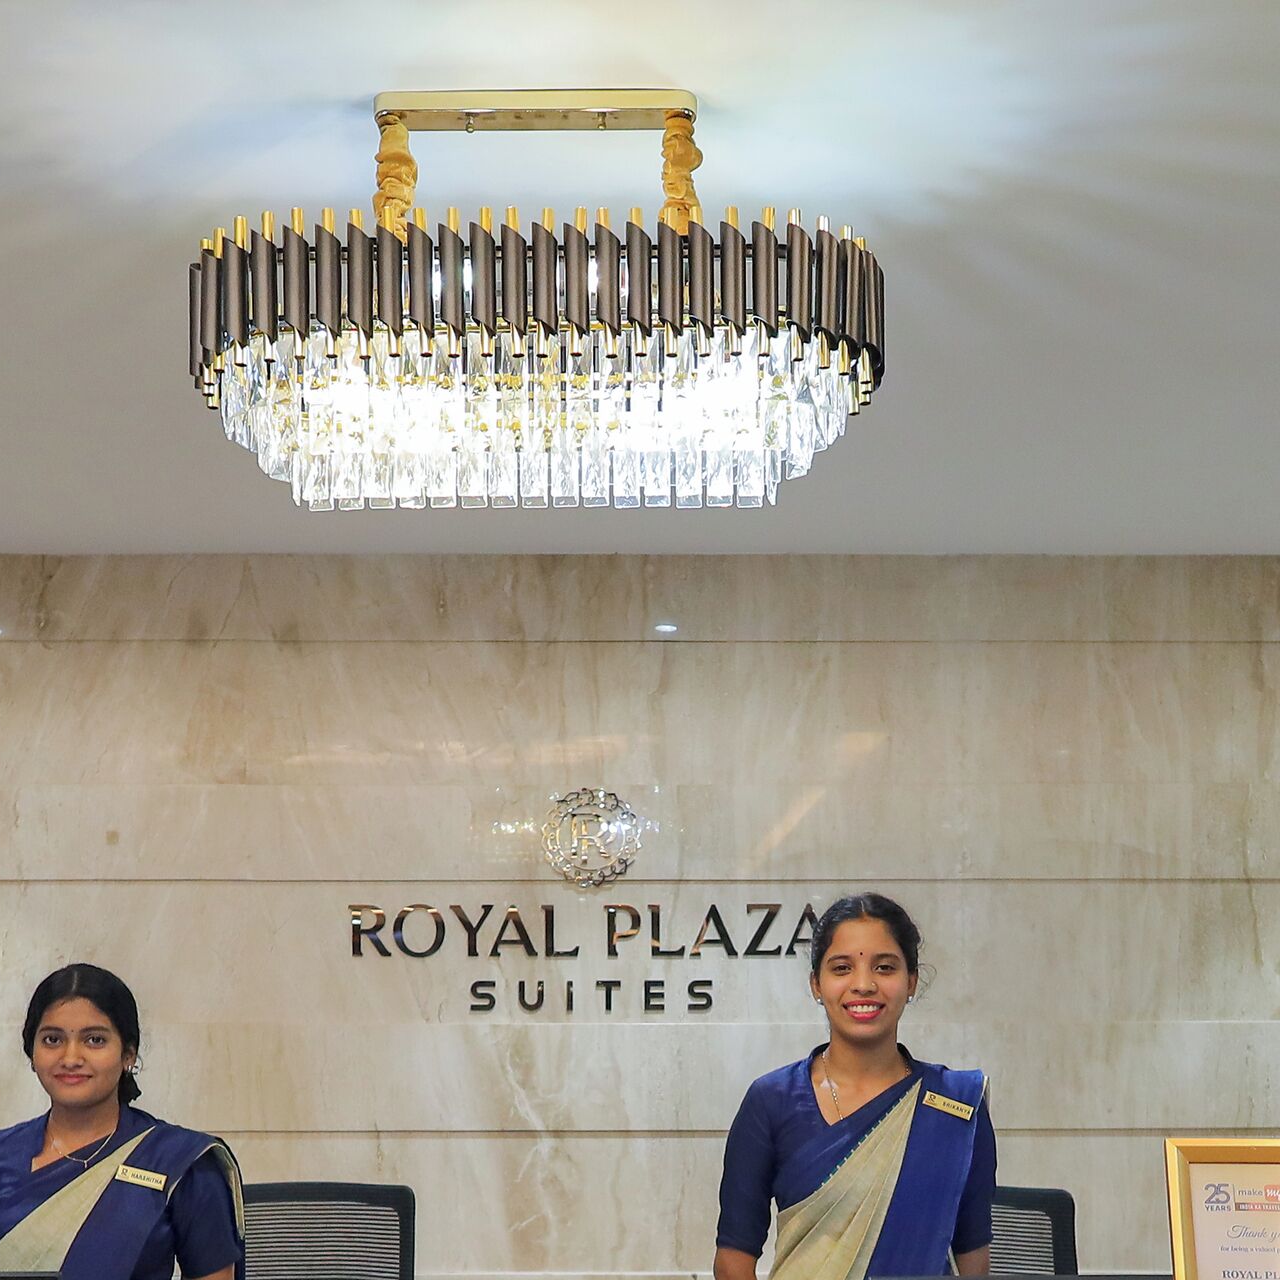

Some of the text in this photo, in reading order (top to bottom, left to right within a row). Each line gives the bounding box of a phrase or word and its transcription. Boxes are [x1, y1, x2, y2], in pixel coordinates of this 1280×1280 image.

[348, 903, 820, 958] ROYAL PLAZA
[470, 979, 713, 1012] SUITES
[1204, 1183, 1231, 1205] 25
[1238, 1188, 1263, 1197] make
[1205, 1204, 1232, 1212] YEARS
[1262, 1203, 1280, 1211] TRAVEL
[1226, 1224, 1268, 1240] Thank
[1230, 1245, 1249, 1253] being
[1222, 1270, 1262, 1280] ROYAL
